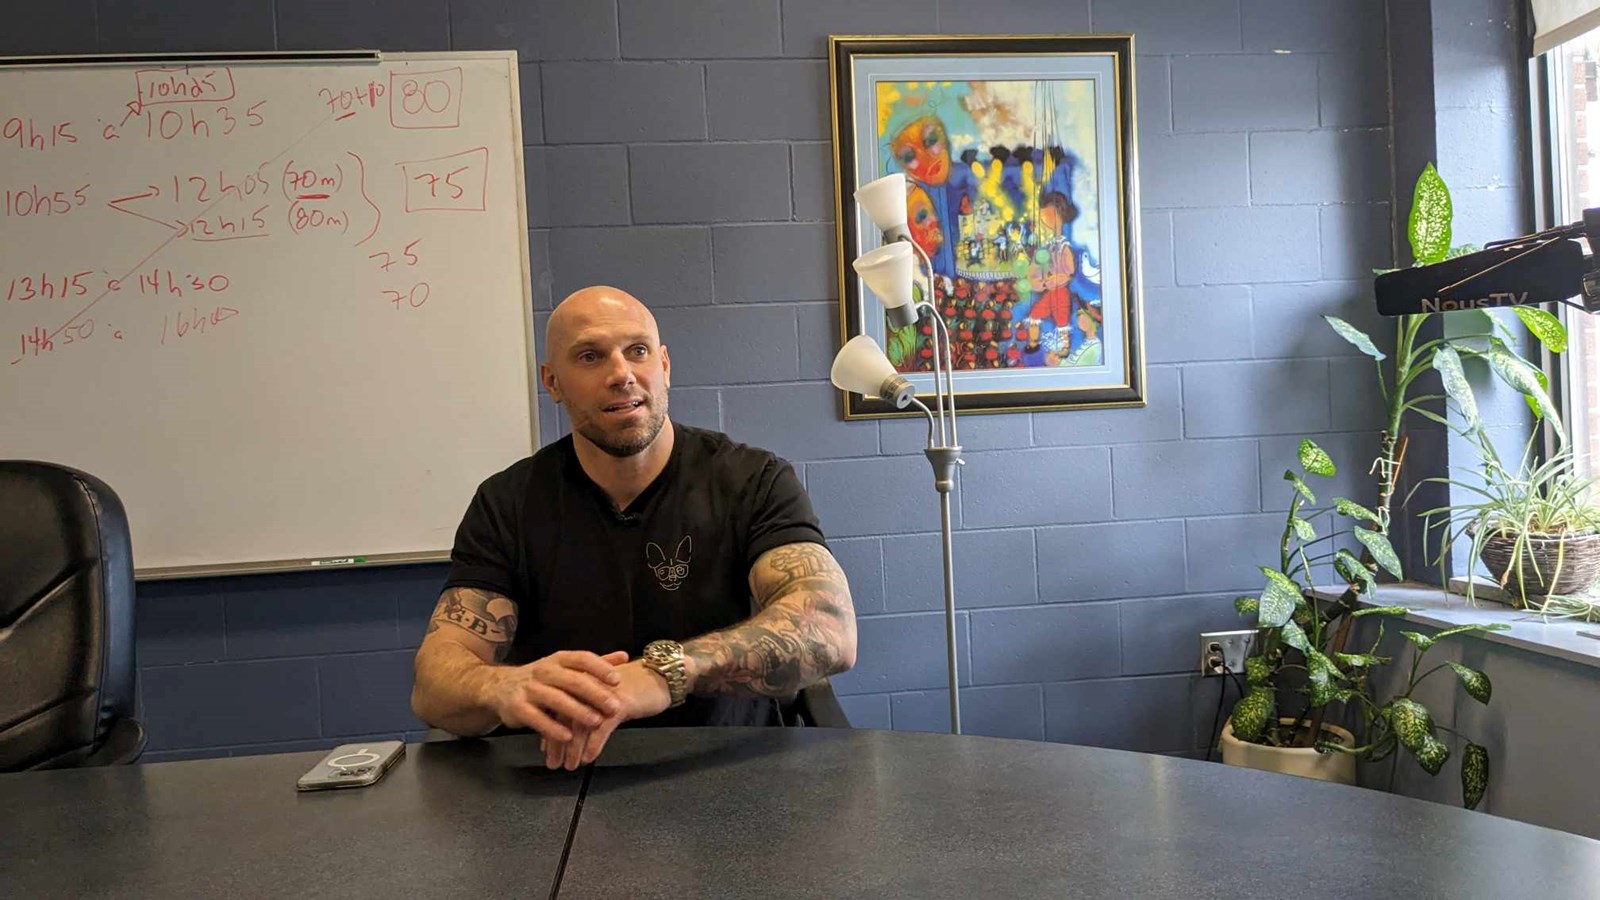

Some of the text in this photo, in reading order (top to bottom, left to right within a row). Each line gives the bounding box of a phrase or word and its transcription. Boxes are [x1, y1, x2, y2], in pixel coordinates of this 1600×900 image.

[402, 80, 450, 114] 80
[3, 118, 77, 151] 9h15
[147, 100, 268, 139] 10h35
[172, 161, 269, 202] 12h05
[414, 166, 469, 199] 75
[6, 183, 91, 216] 10h55
[190, 204, 269, 235] 12h15
[368, 239, 422, 272] 75
[7, 271, 93, 301] 13h15
[382, 282, 430, 309] 70
[1421, 291, 1528, 313] NousTV
[21, 318, 94, 356] 14h50
